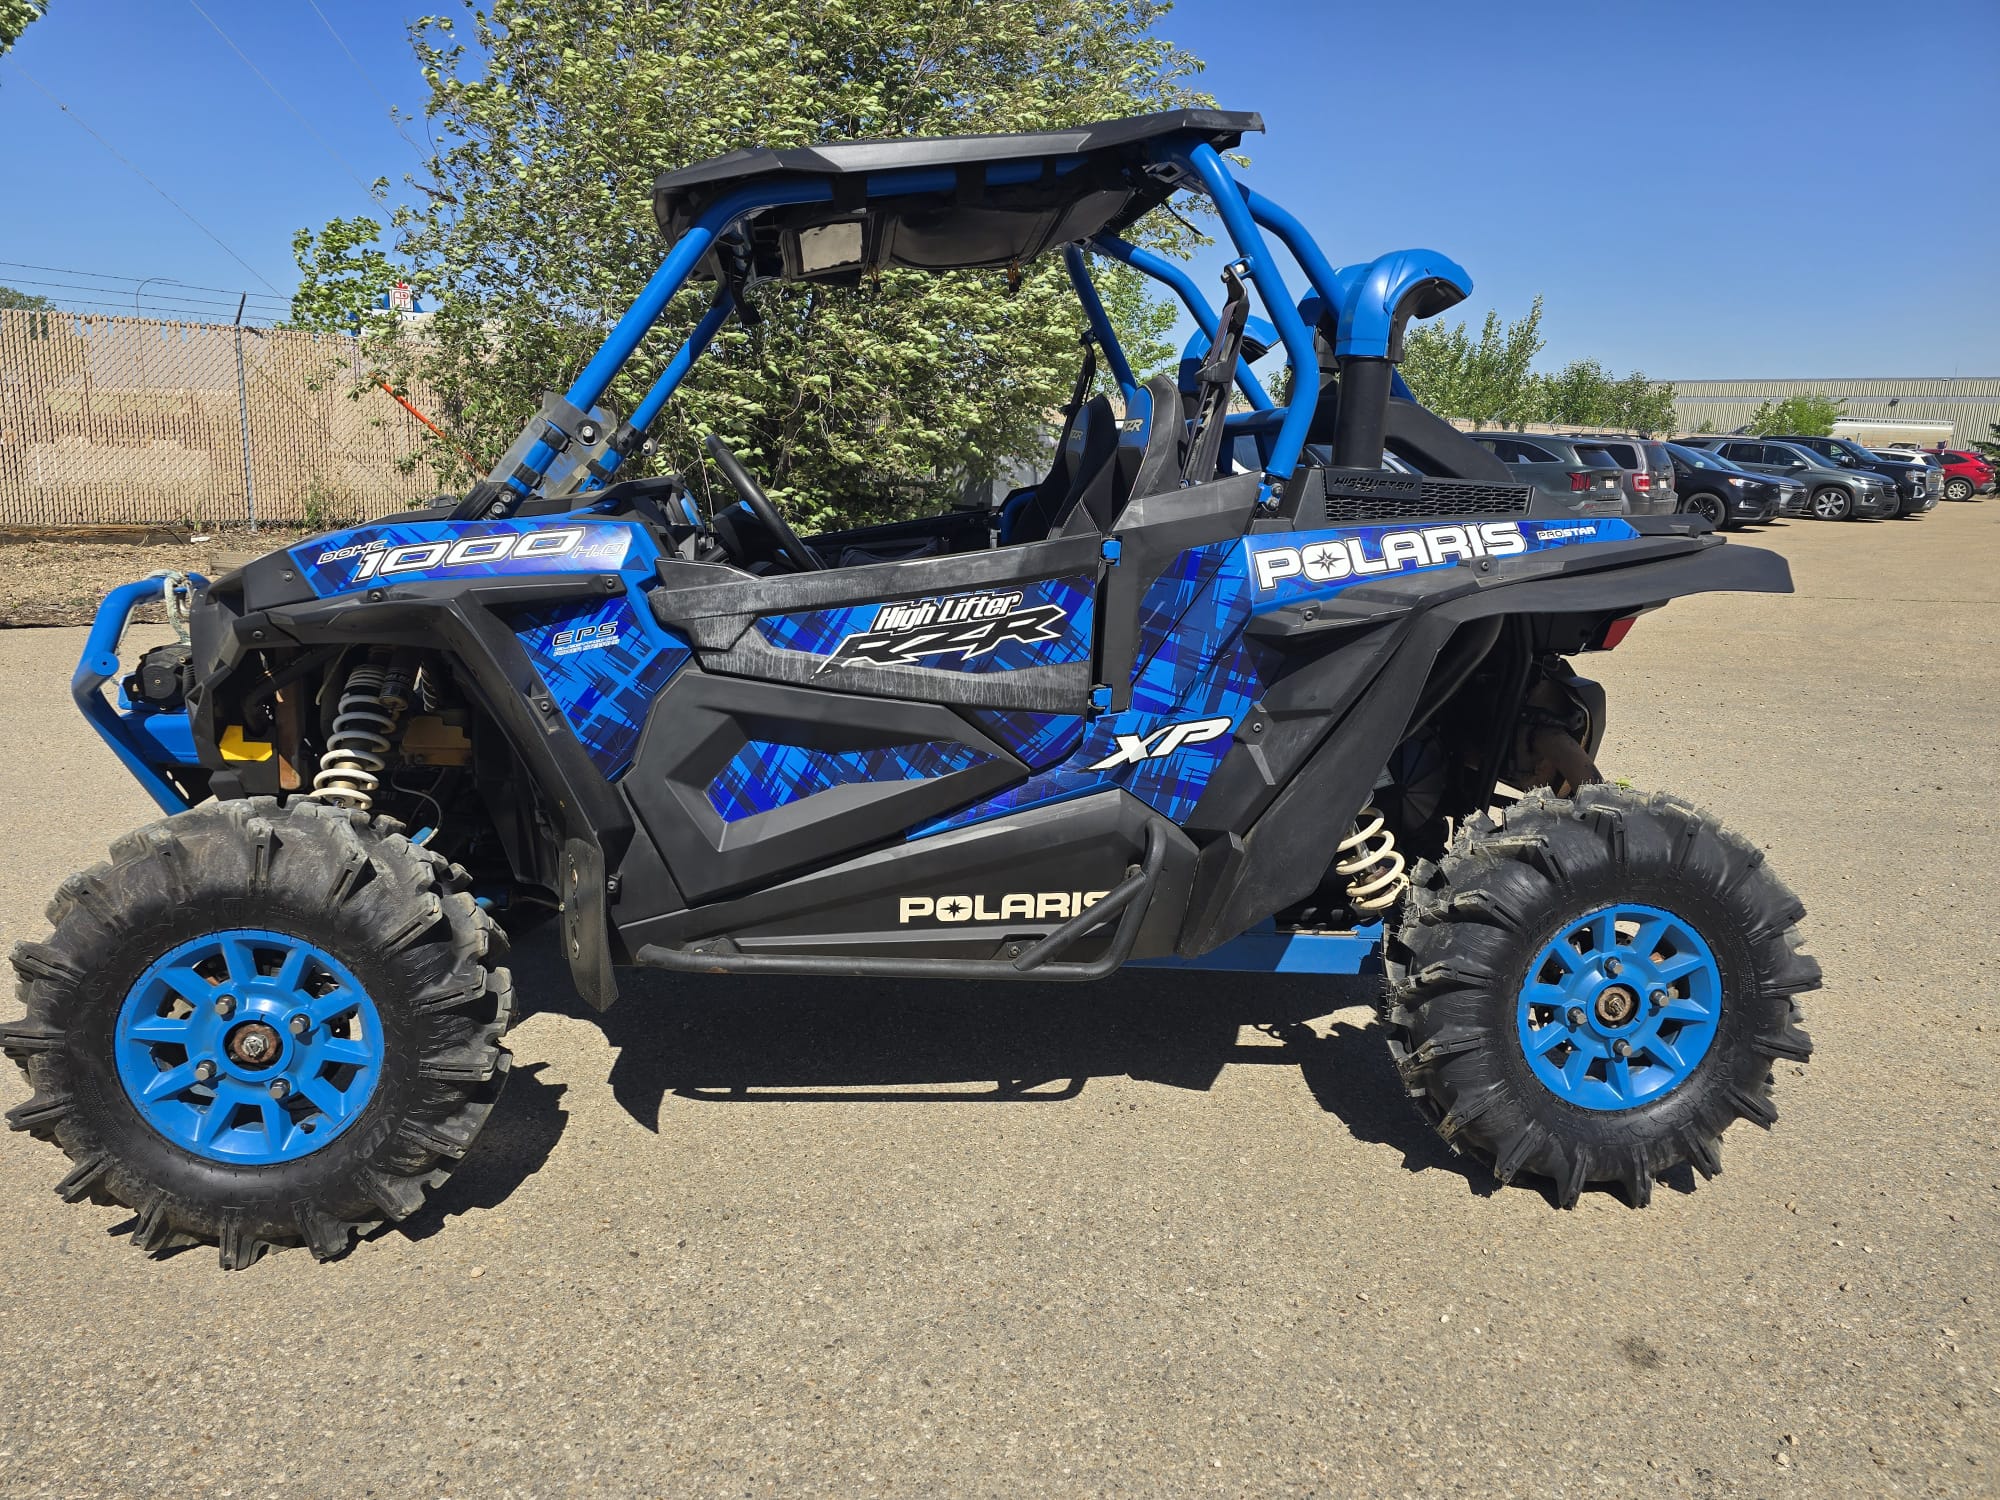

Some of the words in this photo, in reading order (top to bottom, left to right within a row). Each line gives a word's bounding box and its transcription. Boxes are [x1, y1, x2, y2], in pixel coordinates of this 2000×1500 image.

[317, 539, 388, 565] DOHC
[352, 526, 586, 583] 1000
[1252, 520, 1528, 591] POLARIS
[552, 621, 619, 647] EPS
[874, 601, 937, 632] High
[937, 593, 1021, 623] Lifter
[809, 604, 1067, 679] RZR
[1087, 717, 1233, 772] XP
